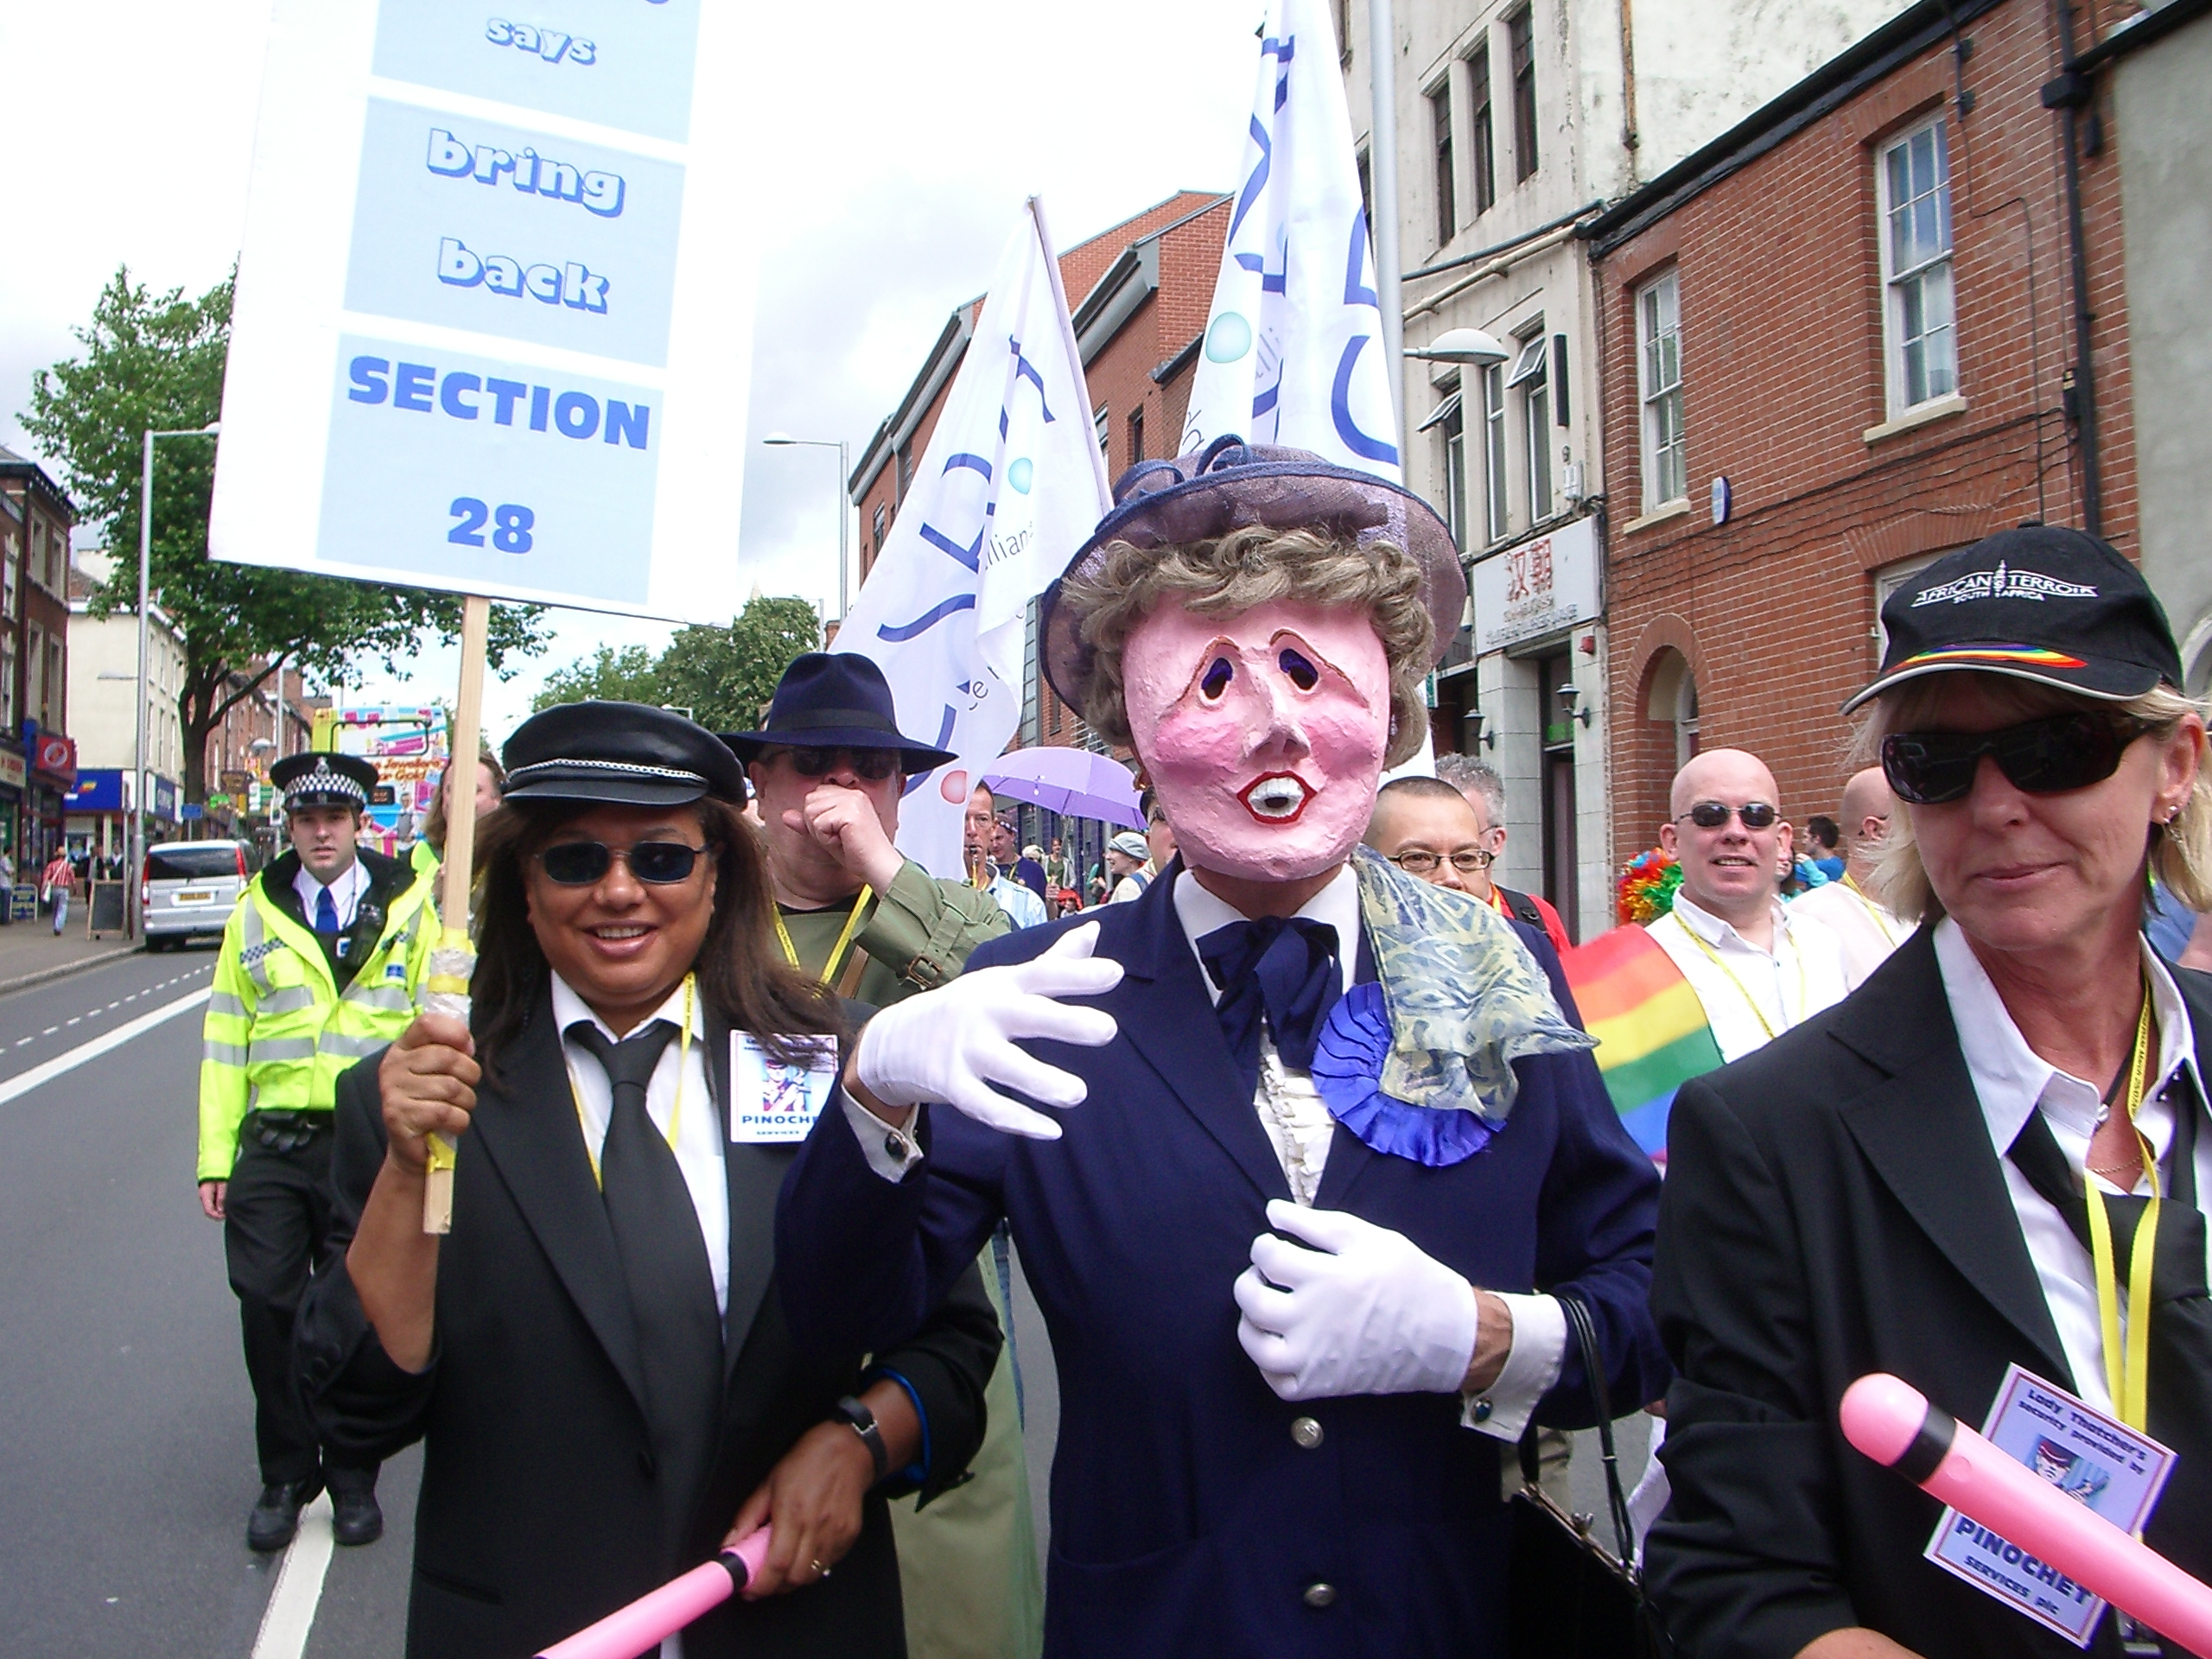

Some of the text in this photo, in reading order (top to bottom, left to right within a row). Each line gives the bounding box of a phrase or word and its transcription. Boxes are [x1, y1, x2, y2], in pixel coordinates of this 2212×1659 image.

[485, 17, 596, 65] says
[426, 127, 626, 218] bring
[437, 237, 609, 315] back
[348, 355, 650, 450] SECTION
[448, 496, 535, 554] 28
[1916, 574, 1992, 602] AFRICAN
[1953, 589, 2045, 604] SOUTH AFRICA
[2018, 1401, 2067, 1431] security
[2028, 1389, 2146, 1461] Lady Thatcher's
[1955, 1516, 2093, 1605] PINOCHET
[1963, 1554, 2060, 1615] SERVICES plc
